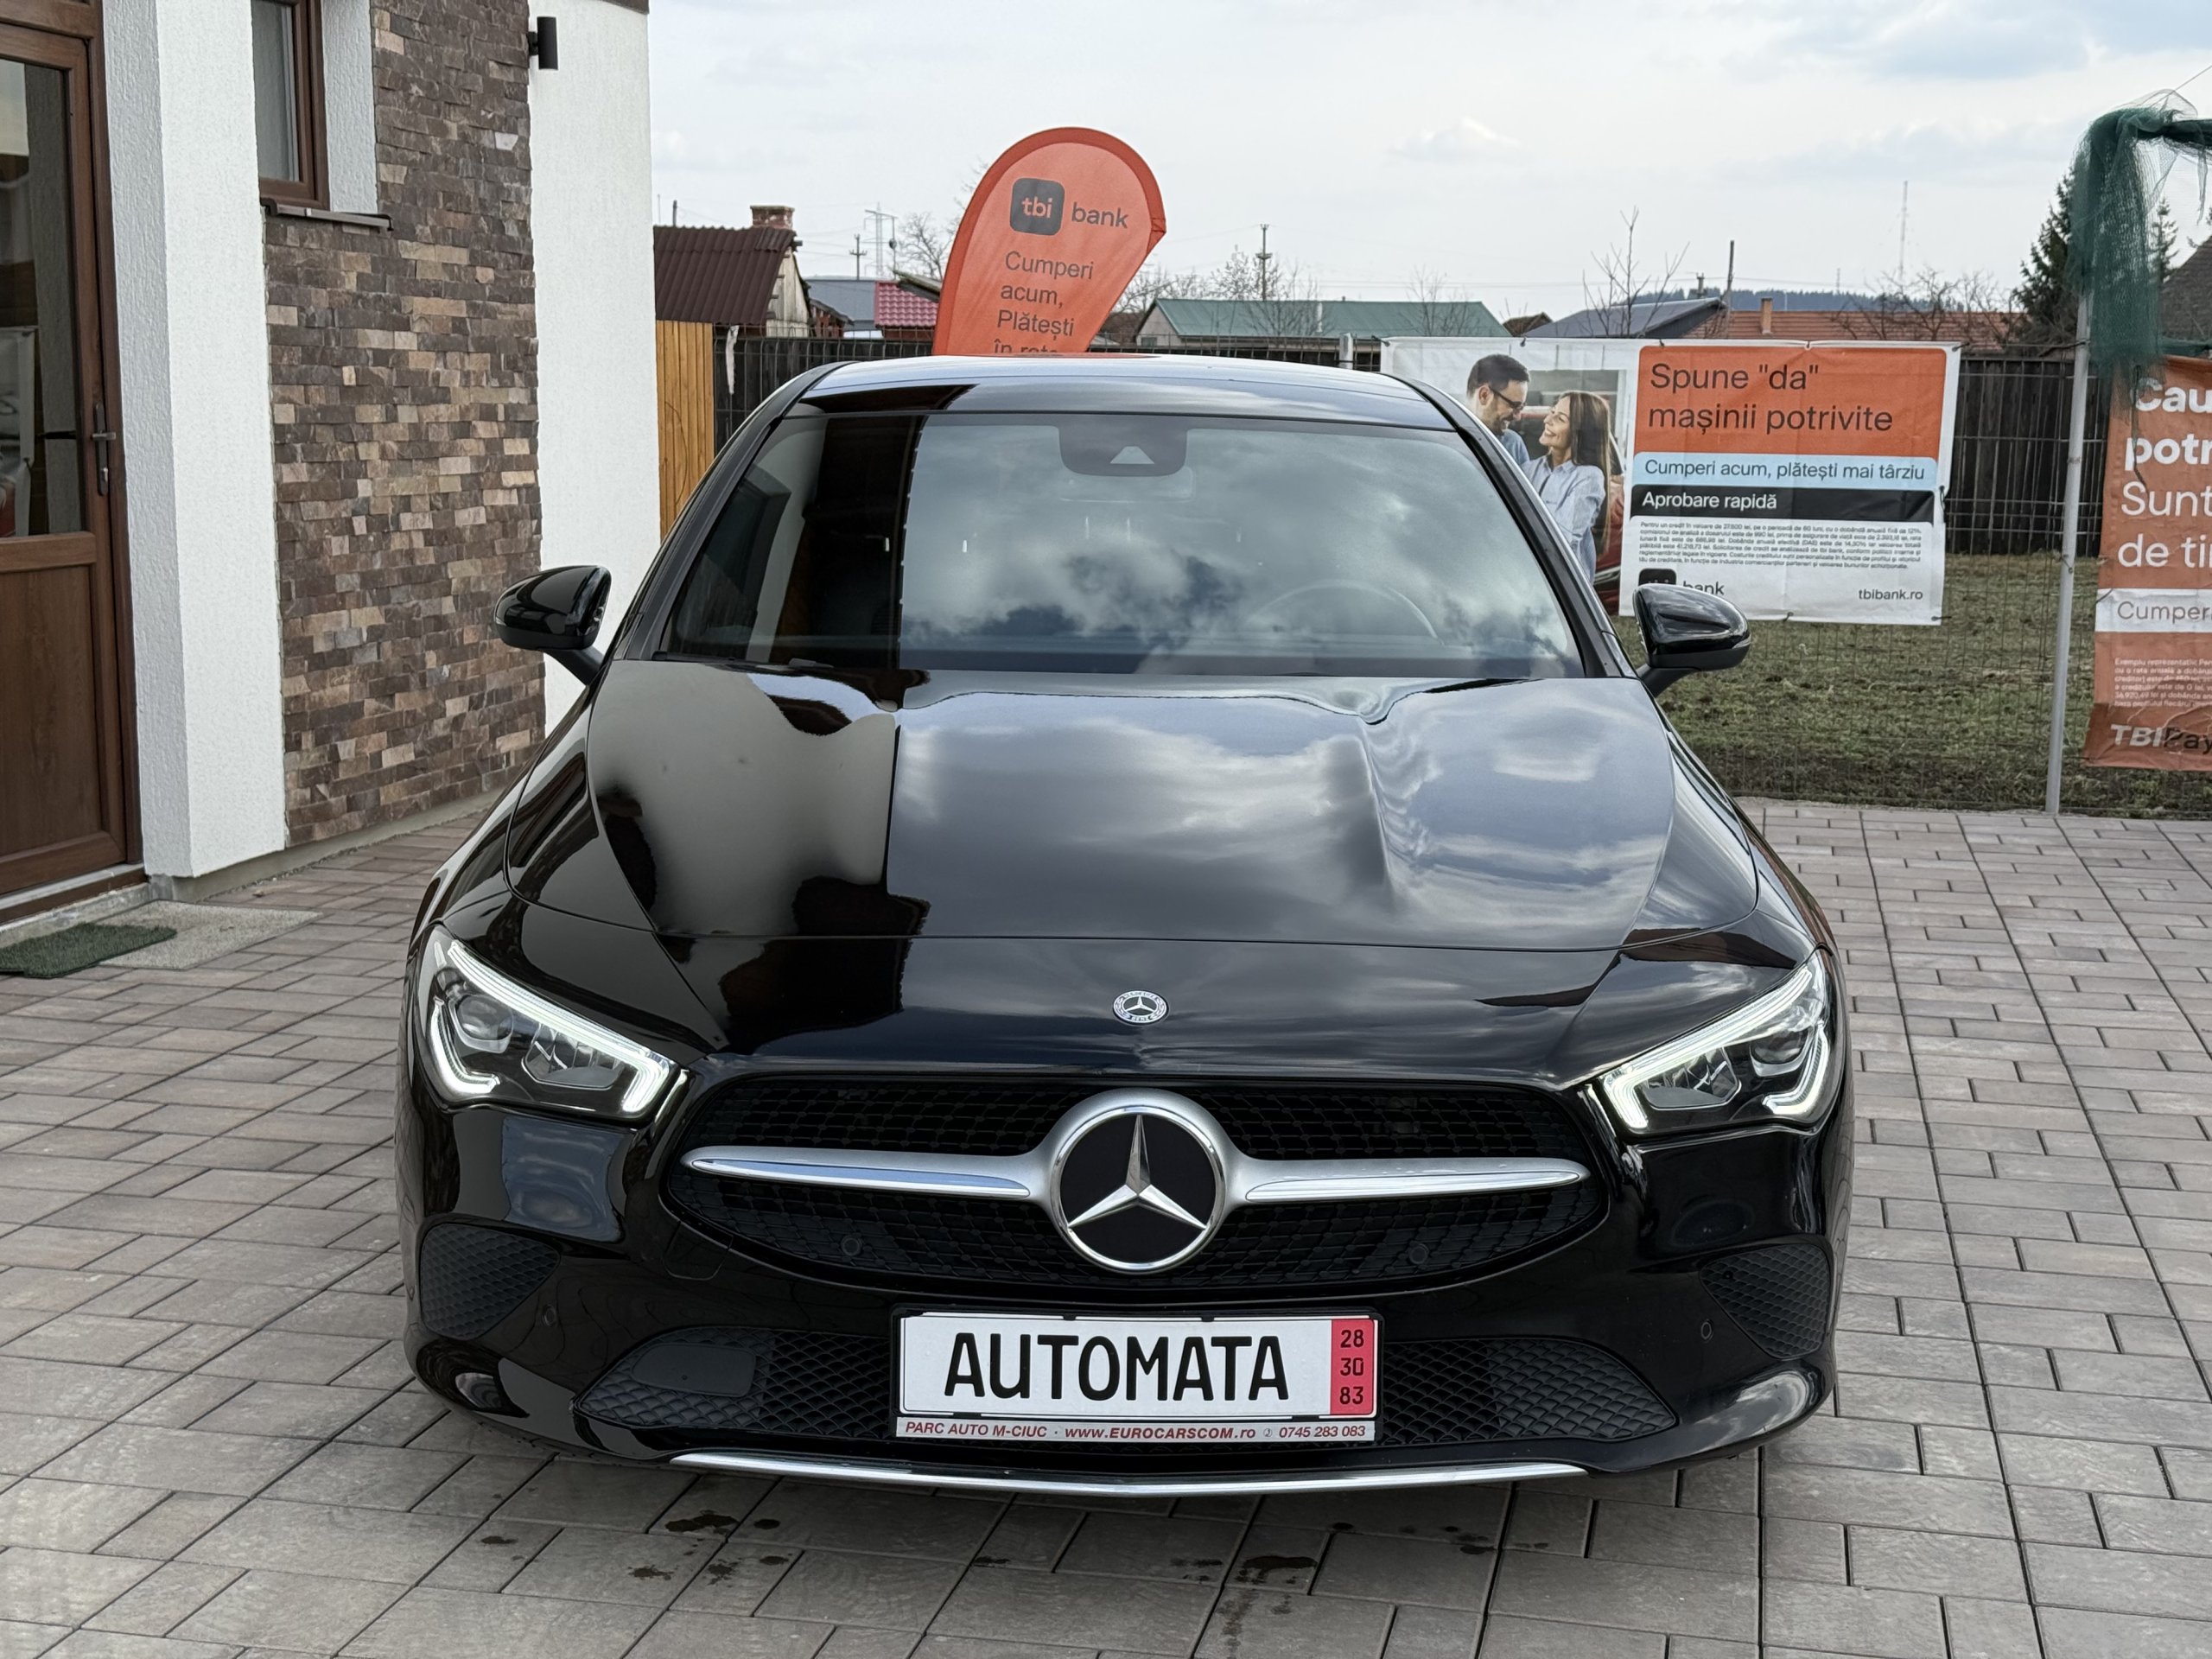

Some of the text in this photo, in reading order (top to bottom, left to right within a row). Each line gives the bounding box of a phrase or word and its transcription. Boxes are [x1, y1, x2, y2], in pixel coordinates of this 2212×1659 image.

[1021, 197, 1128, 228] tbi bank
[1005, 251, 1094, 280] Cumperi
[1001, 284, 1063, 308] acum,
[997, 310, 1075, 340] Plătești
[995, 339, 1013, 353] în
[1650, 363, 1819, 394] Spune "da"
[2130, 378, 2212, 413] Cau
[1649, 404, 1893, 435] mașinii potrivite
[2125, 434, 2212, 471] potr
[1645, 460, 1924, 480] Cumperi acum, plătești mai târziu
[1642, 492, 1777, 512] Aprobare rapidă
[2121, 481, 2212, 517] Sunt
[2118, 533, 2212, 569] de ti
[1859, 588, 1923, 600] tbibank.ro
[2118, 601, 2212, 624] Cumper
[1340, 1329, 1364, 1348] 28
[944, 1332, 1289, 1401] AUTOMATA
[1339, 1357, 1364, 1376] 30
[1339, 1386, 1364, 1405] 83
[906, 1421, 1365, 1440] PARC AUTO M-CIUC www.EUROCARSCOM.ro 0745 283 083
